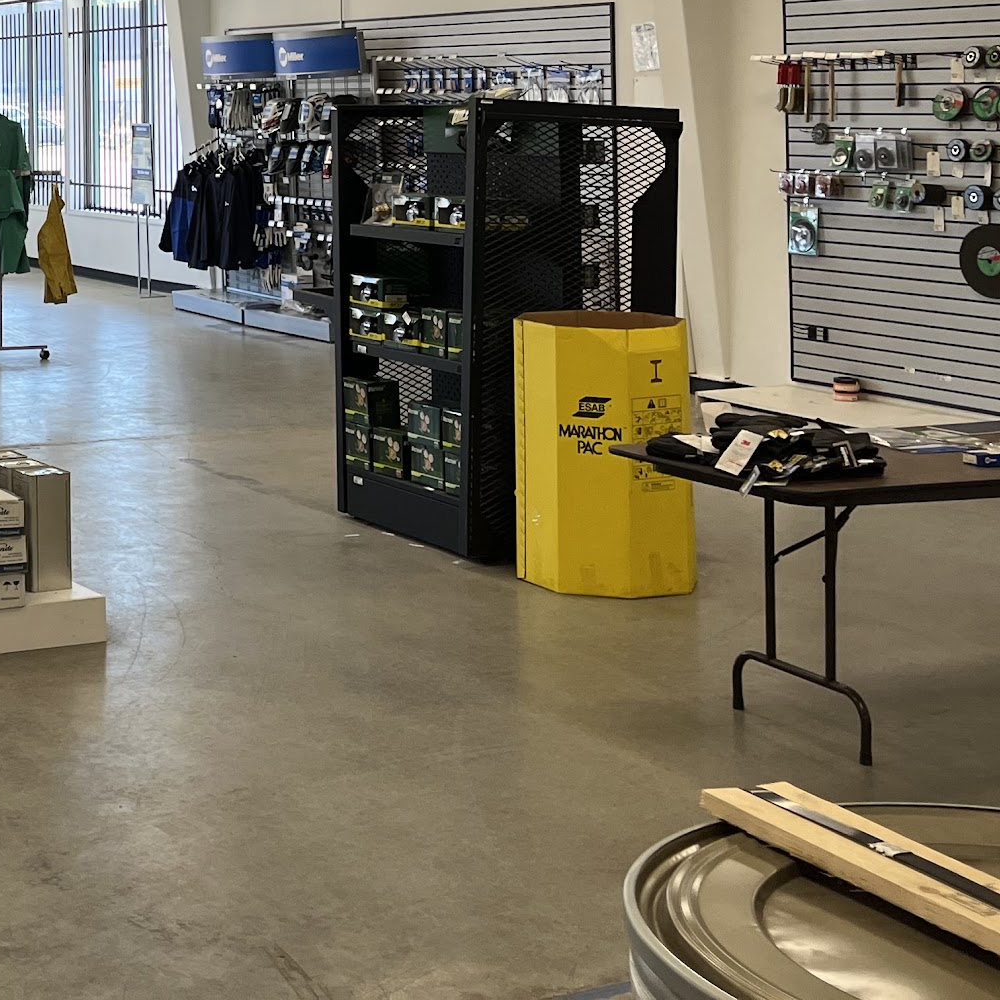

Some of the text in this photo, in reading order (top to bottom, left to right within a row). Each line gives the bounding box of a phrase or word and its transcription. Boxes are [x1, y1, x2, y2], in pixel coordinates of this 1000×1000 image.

[578, 402, 606, 412] ESAB
[559, 423, 623, 442] MARATHON
[577, 440, 603, 455] PAC
